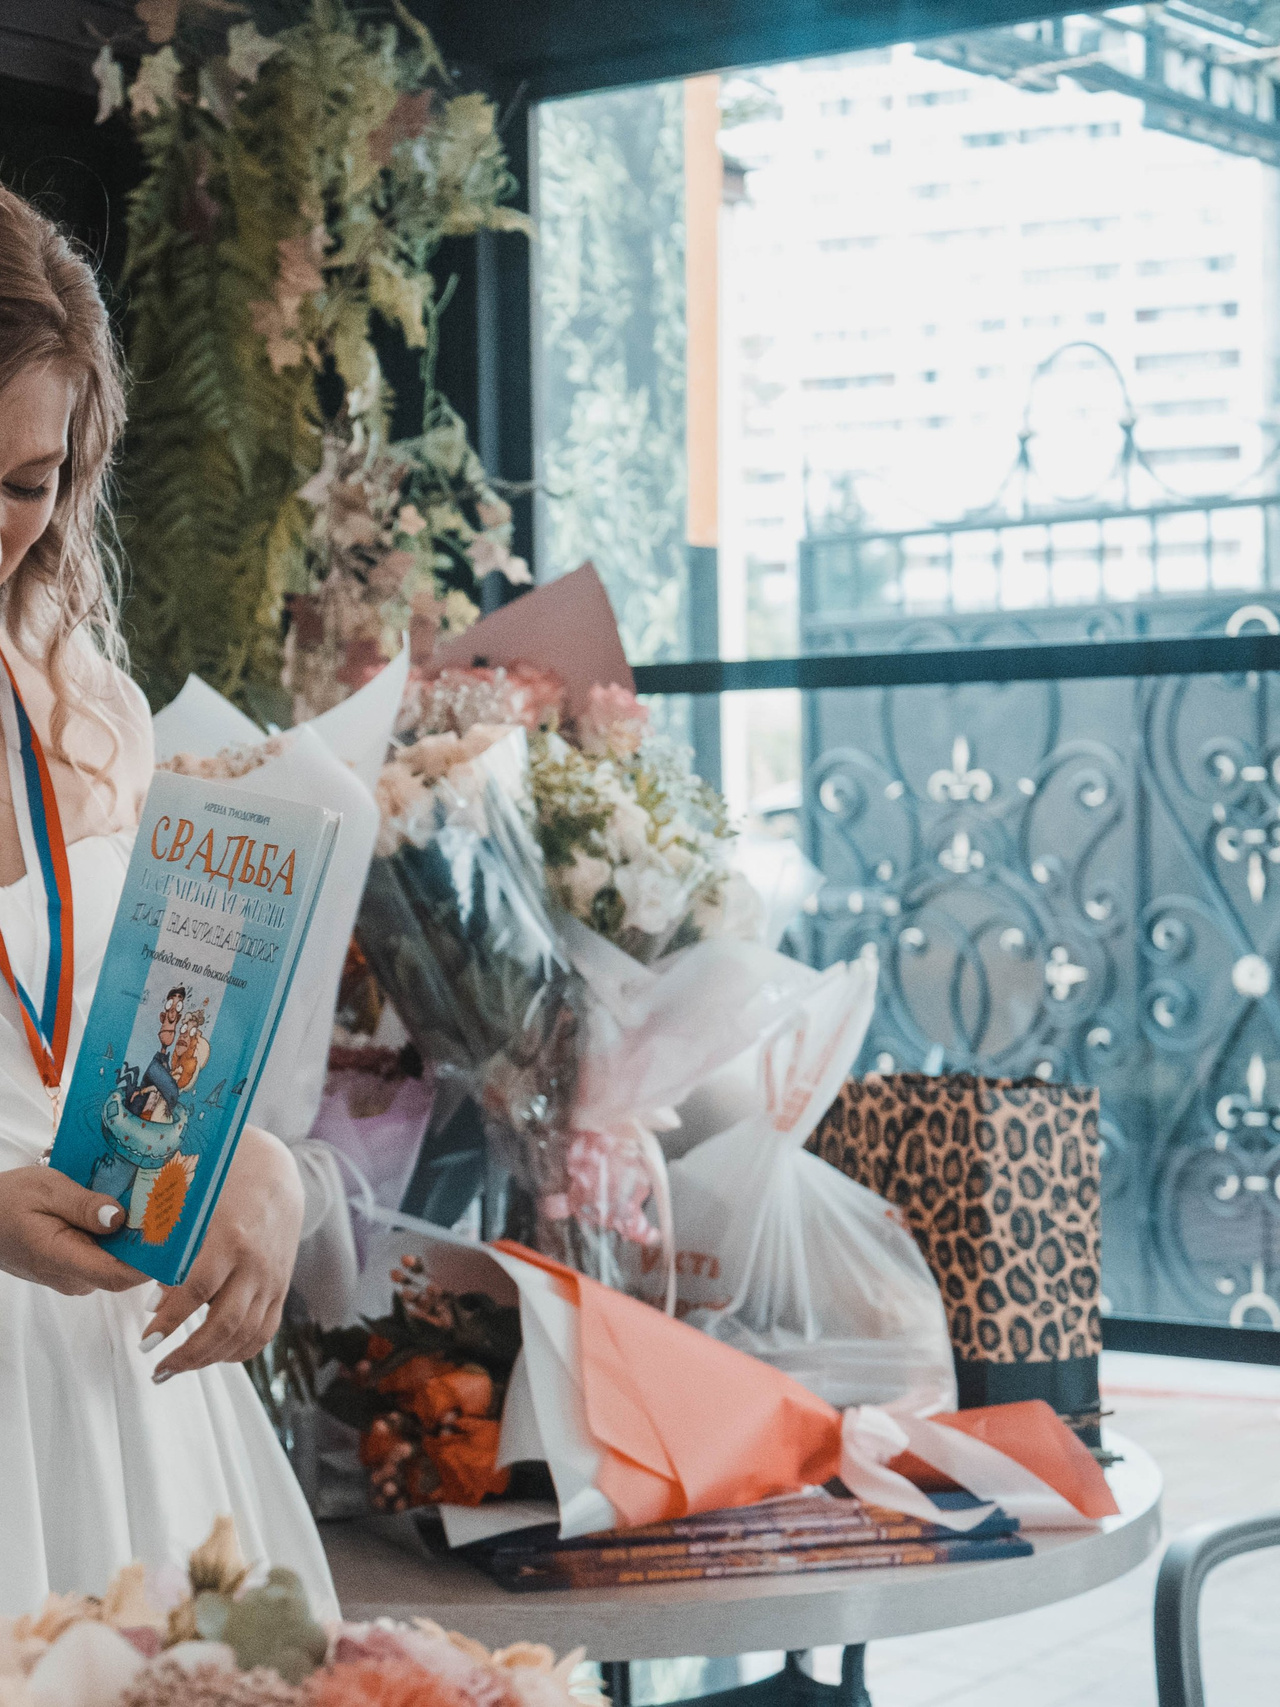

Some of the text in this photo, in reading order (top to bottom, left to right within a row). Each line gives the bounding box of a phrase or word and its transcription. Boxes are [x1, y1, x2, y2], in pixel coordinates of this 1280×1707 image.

[204, 802, 271, 826] ИРЕНА ТИОДОРОВИЧ
[151, 815, 297, 895] СВАДЬБА
[131, 903, 280, 963] ДЛЯ НАЧИНАЮЩИХ
[239, 897, 287, 931] ЖИЗНЬ
[141, 943, 248, 989] Руководство по выживанию
